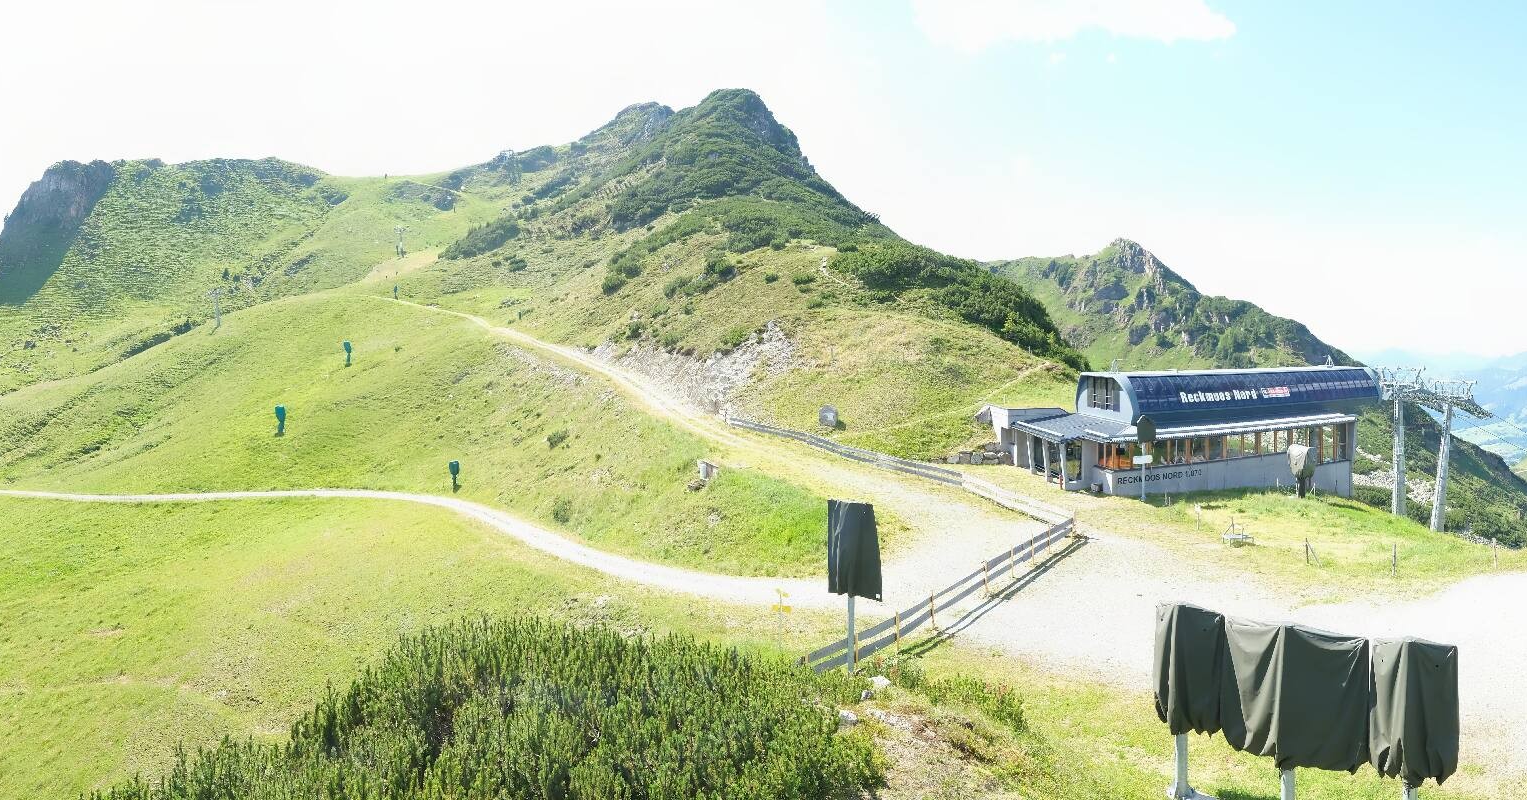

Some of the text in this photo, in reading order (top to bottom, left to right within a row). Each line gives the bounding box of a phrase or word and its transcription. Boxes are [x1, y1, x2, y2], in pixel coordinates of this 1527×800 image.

[1180, 391, 1231, 403] Reckmoos
[1233, 389, 1258, 400] Nord
[1162, 471, 1183, 480] NORD
